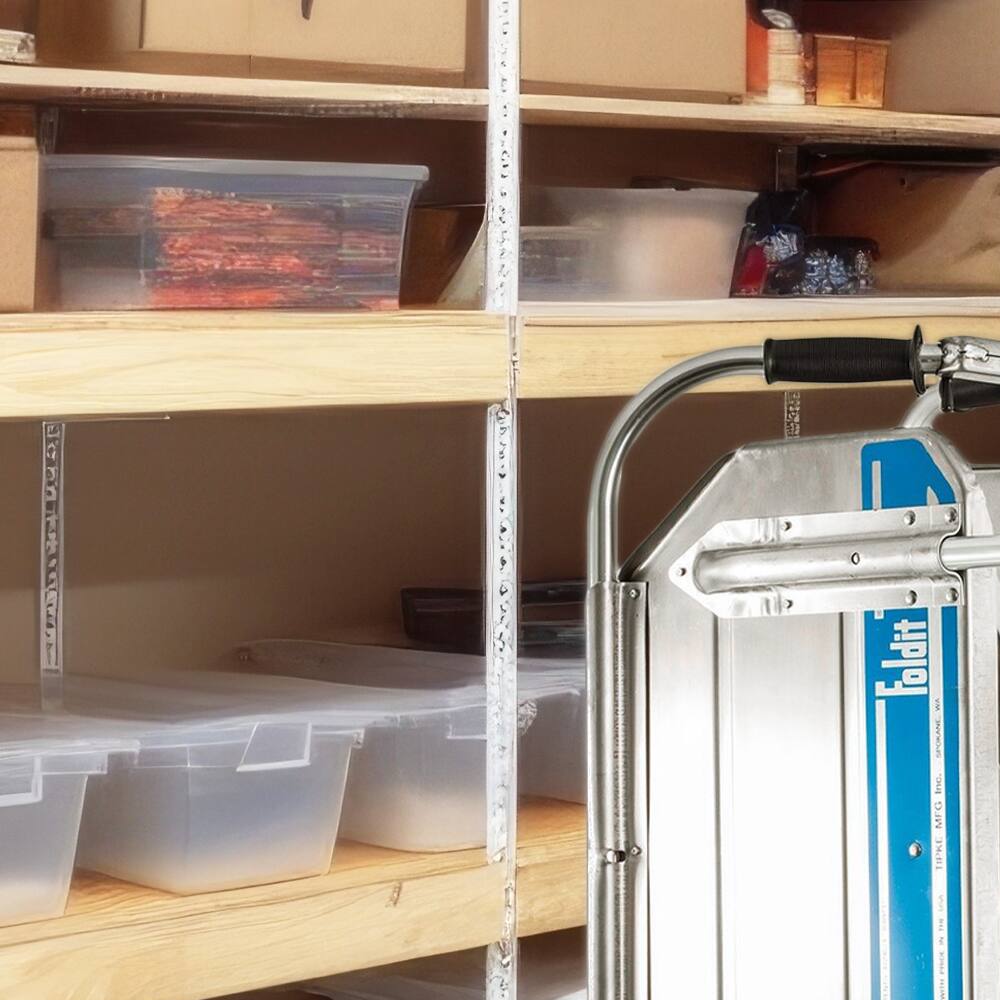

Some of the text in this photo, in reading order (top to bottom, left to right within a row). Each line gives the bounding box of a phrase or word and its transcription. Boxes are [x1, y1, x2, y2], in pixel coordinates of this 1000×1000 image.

[875, 619, 928, 696] Foldit
[933, 773, 943, 871] TIPKE MFG Inc.
[938, 979, 946, 1000] WITH
